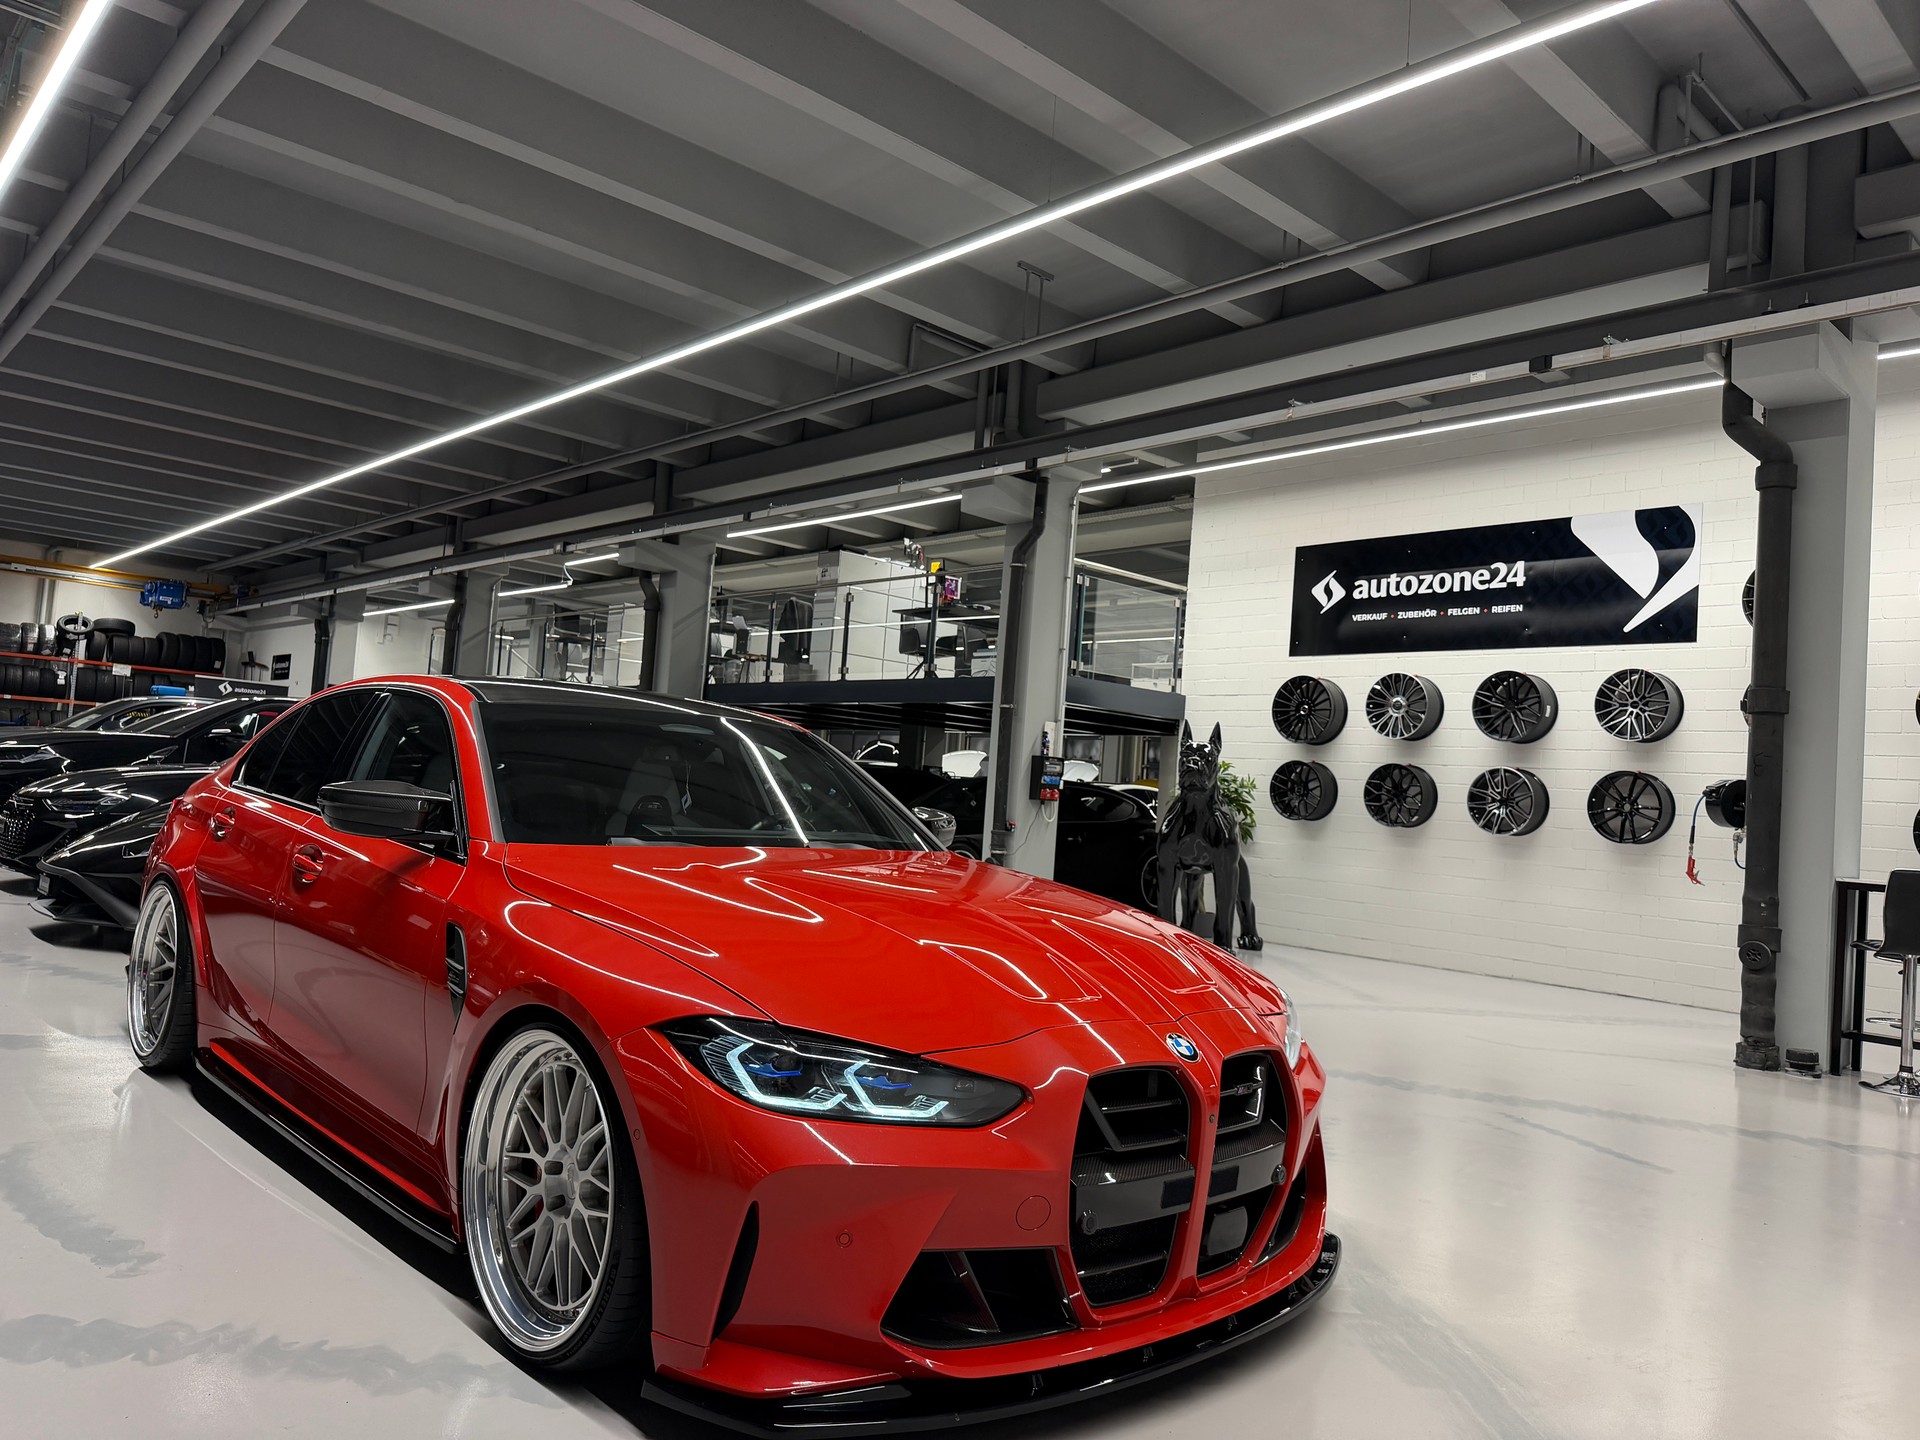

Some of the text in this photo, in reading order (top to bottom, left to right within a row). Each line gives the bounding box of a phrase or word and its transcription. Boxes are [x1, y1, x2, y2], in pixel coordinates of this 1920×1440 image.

[1352, 560, 1526, 600] autozone24
[1352, 604, 1523, 622] VERKAUF ZUBEHÖR FELGEN REIFEN
[234, 687, 266, 695] autozone24
[592, 1267, 616, 1327] MICHELIN
